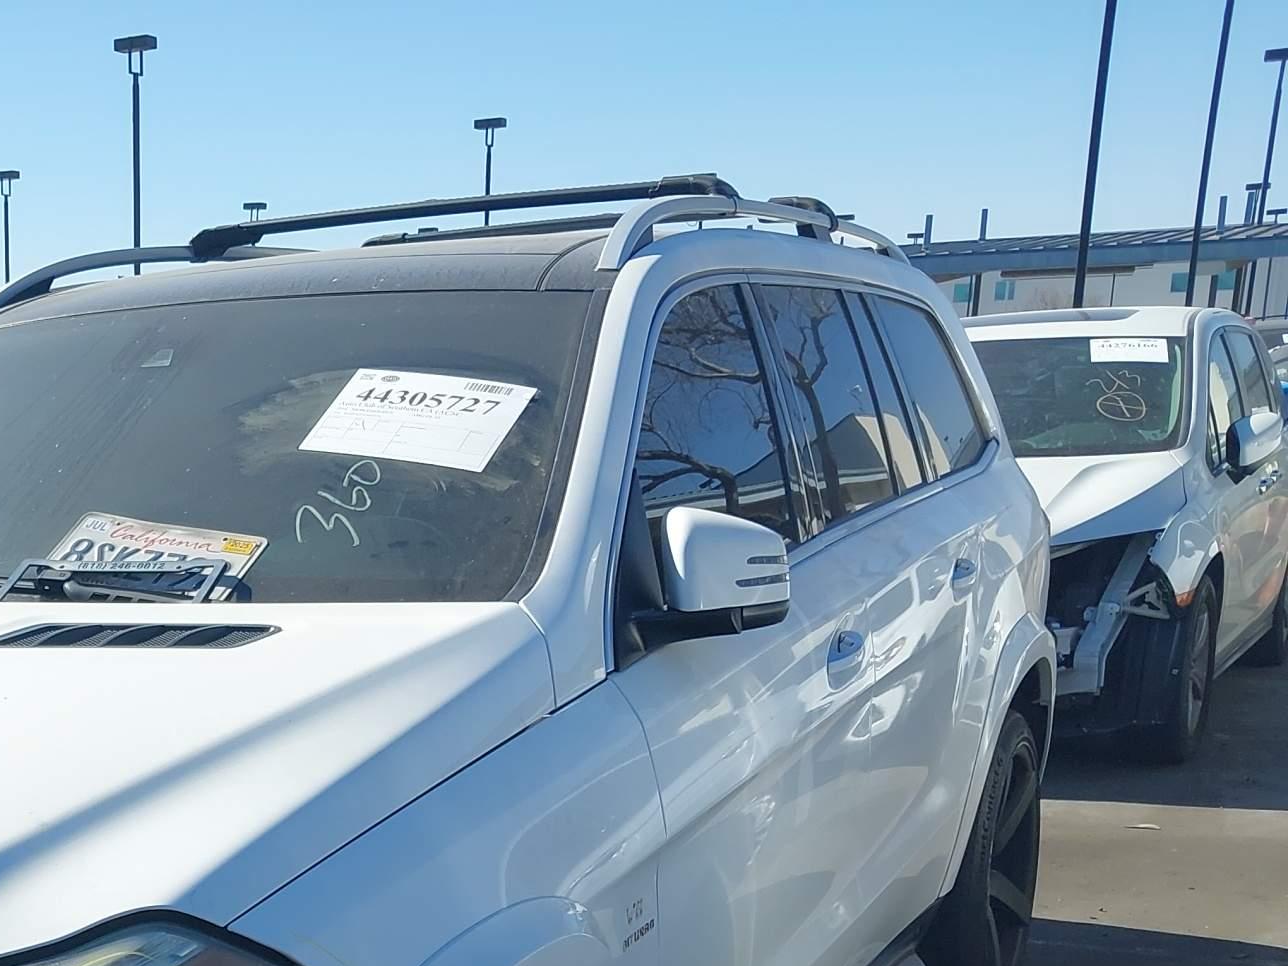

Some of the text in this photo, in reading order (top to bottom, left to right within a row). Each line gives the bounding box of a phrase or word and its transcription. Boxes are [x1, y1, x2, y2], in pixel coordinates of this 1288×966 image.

[355, 387, 501, 415] 44305727
[295, 460, 381, 547] 360
[86, 519, 221, 553] JUL California
